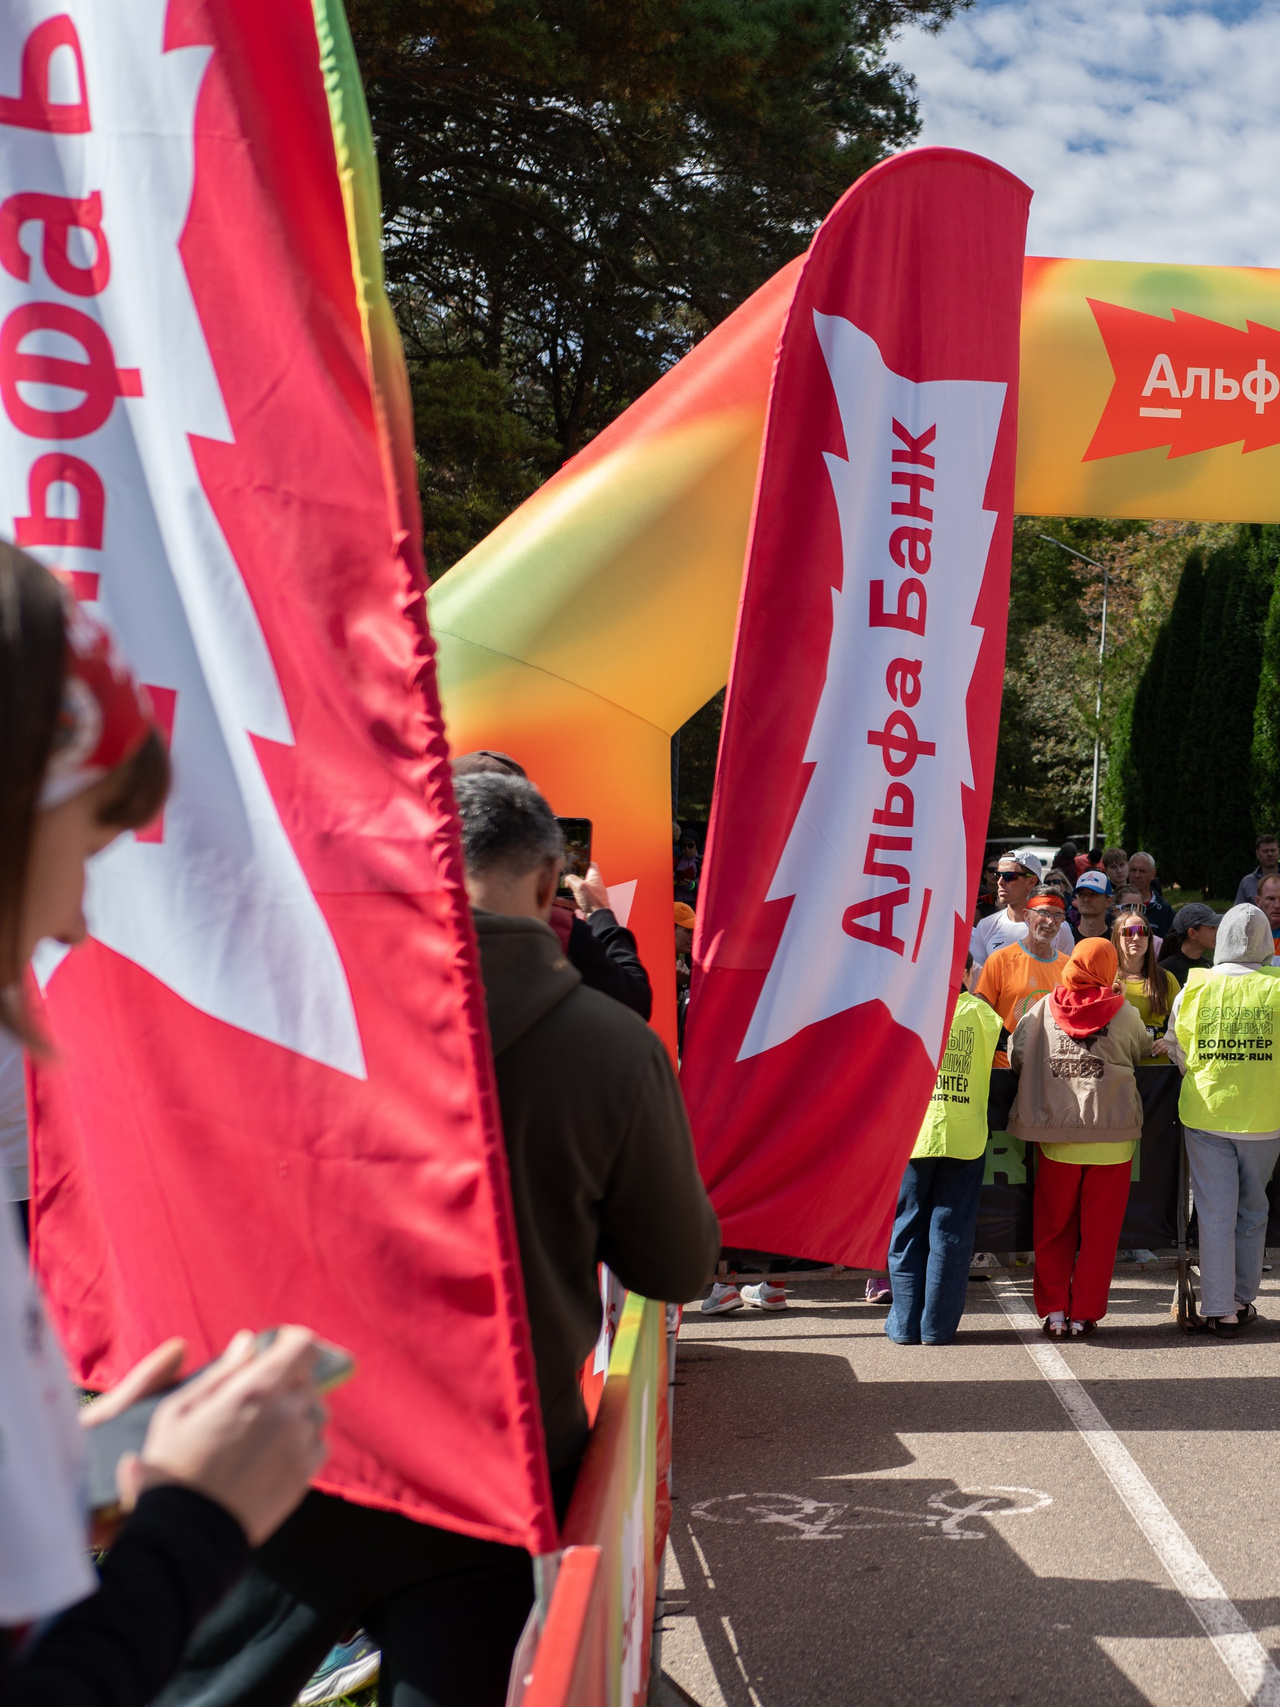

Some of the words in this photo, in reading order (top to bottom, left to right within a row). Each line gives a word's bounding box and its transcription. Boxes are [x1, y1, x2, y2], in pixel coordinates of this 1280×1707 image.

[869, 417, 938, 638] Банк
[842, 659, 937, 957] Альфа
[1198, 1004, 1274, 1021] САМЫЙ
[1198, 1021, 1274, 1035] ЛУЧШИЙ
[1197, 1036, 1273, 1049] ВОЛОНТЁР
[941, 1052, 973, 1075] ШИЙ
[936, 1074, 969, 1093] ОНТЁР
